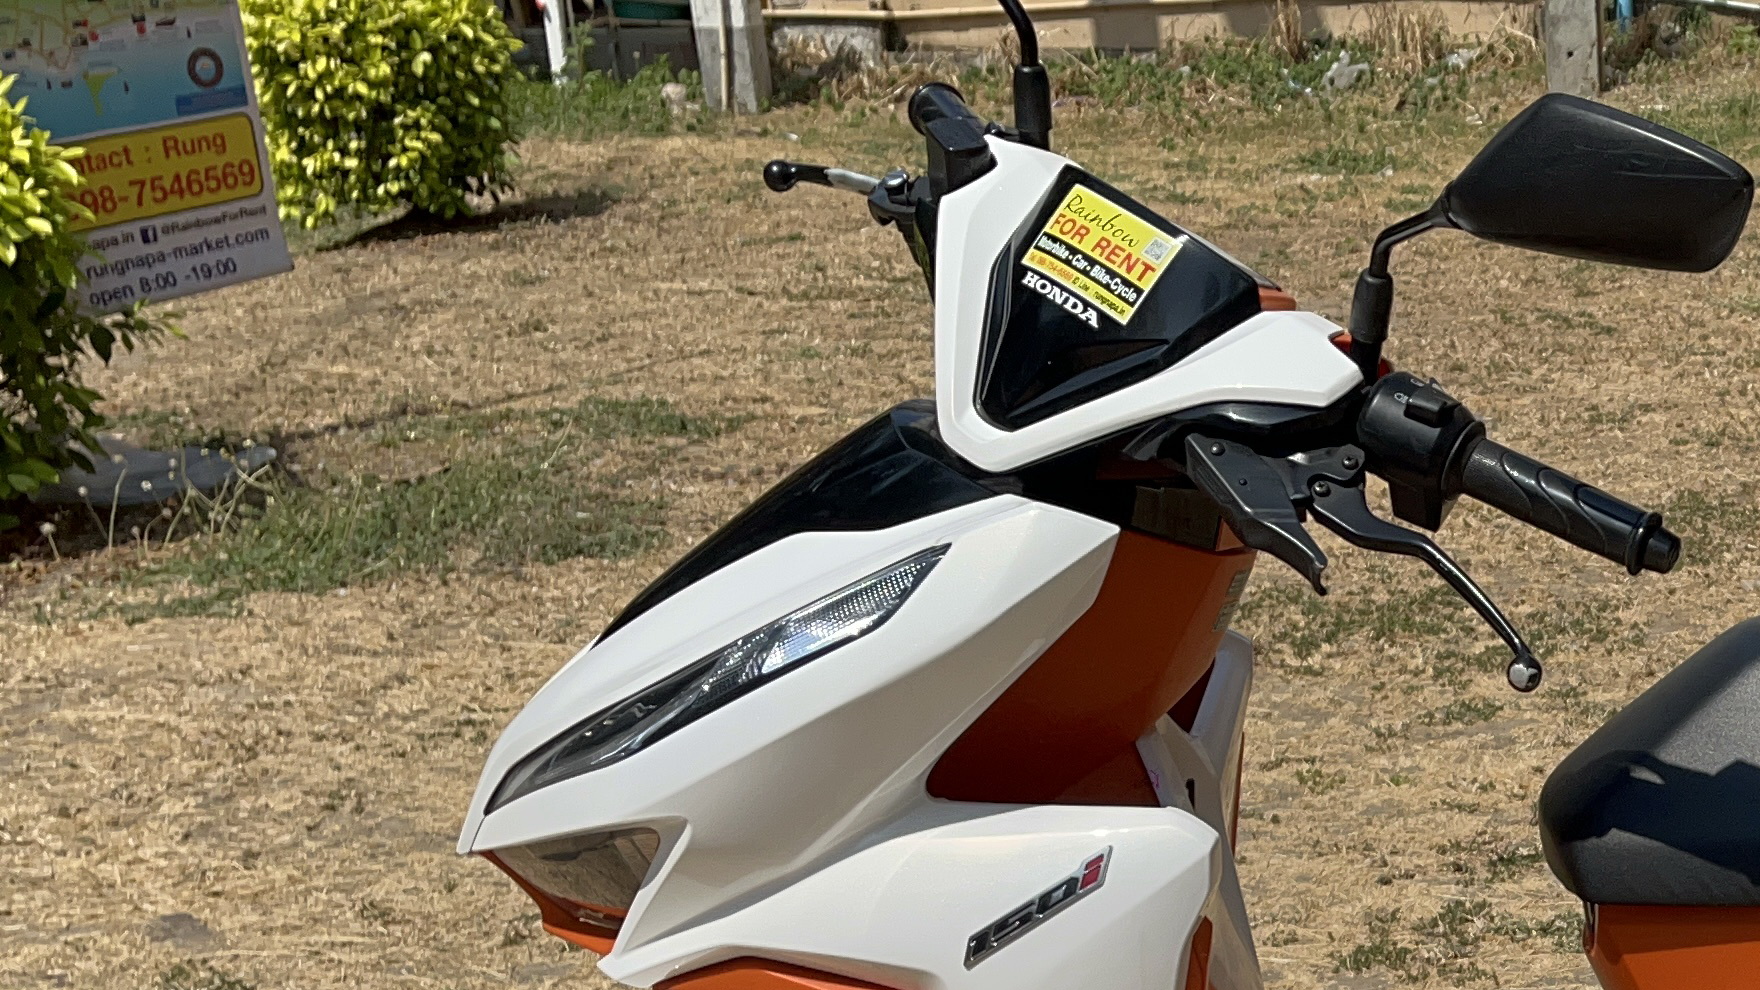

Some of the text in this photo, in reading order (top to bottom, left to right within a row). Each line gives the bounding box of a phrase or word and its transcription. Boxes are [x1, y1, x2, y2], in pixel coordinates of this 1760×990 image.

[70, 144, 134, 175] ntact
[162, 132, 227, 160] Rung
[1049, 212, 1091, 245] FOR
[1091, 236, 1158, 283] RENT
[1063, 193, 1140, 249] Rainbow
[90, 285, 135, 306] open
[1020, 270, 1099, 329] HONDA
[1071, 254, 1088, 270] Car
[1090, 264, 1138, 302] Bike-Cycle
[963, 845, 1114, 971] 150i
